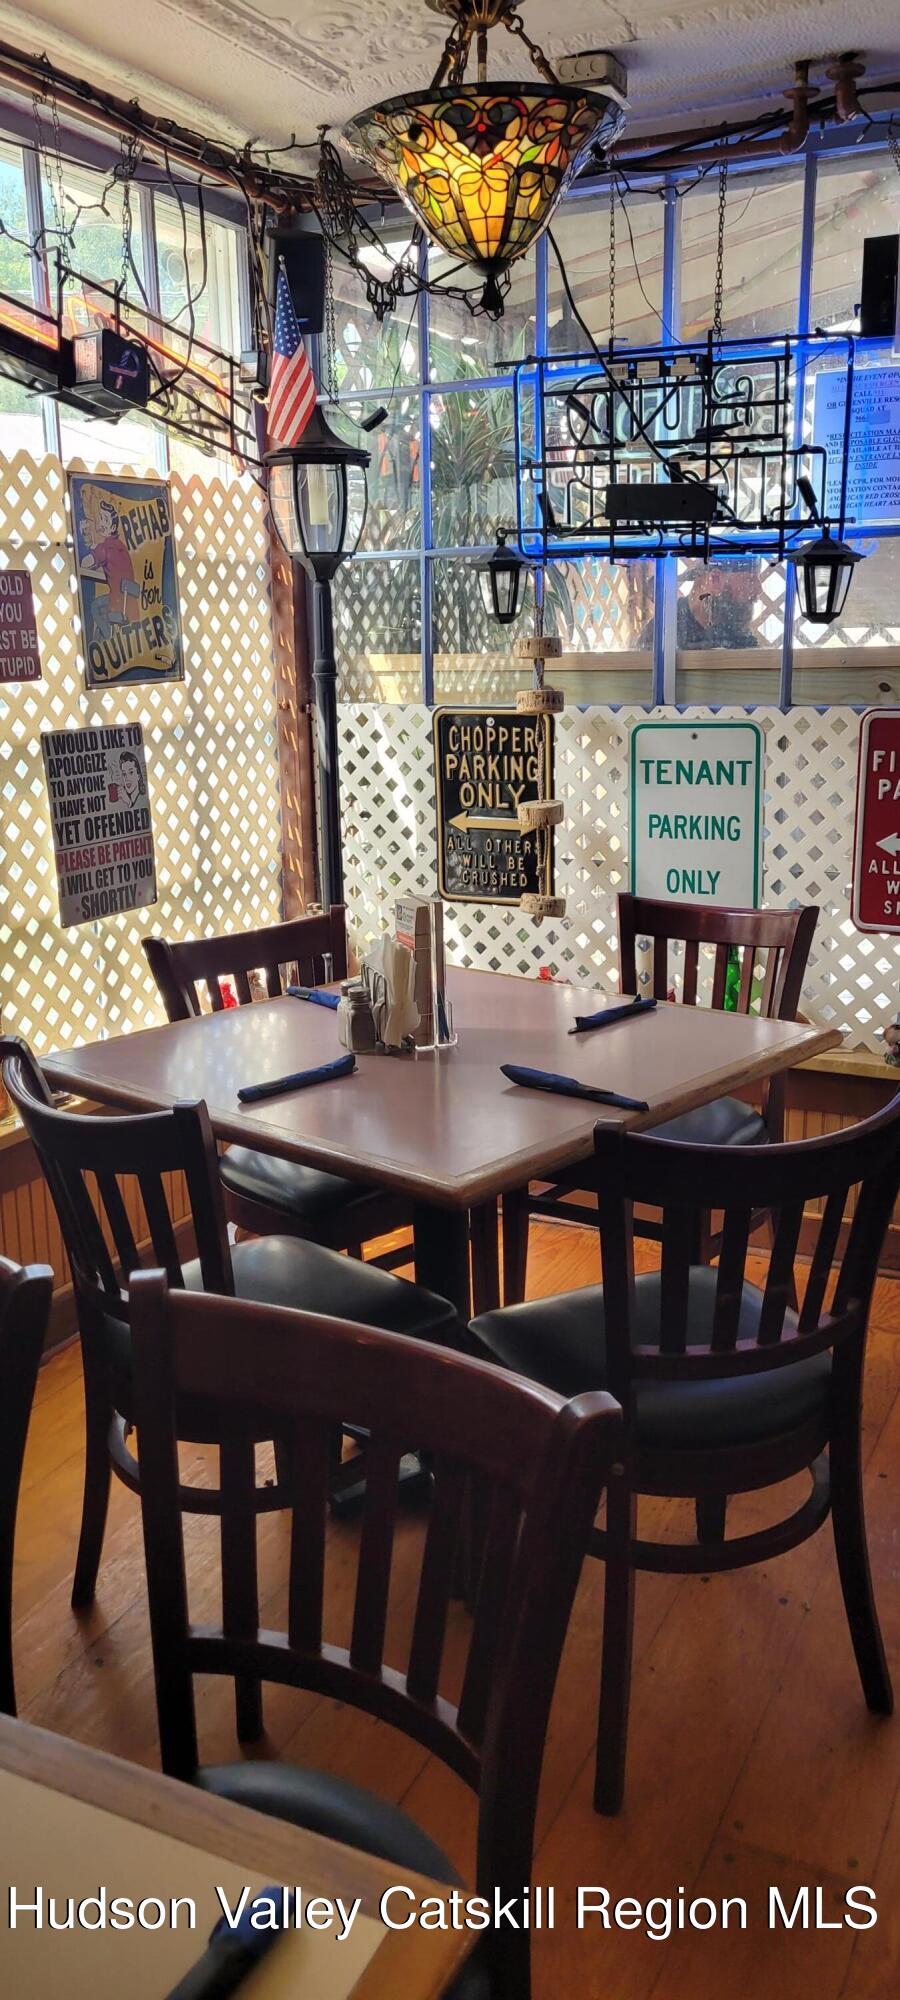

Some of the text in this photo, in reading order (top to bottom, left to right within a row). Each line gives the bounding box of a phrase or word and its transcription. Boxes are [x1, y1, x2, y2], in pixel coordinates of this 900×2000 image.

[120, 498, 169, 550] REHAB
[143, 560, 153, 580] is
[141, 582, 161, 611] for
[20, 629, 37, 649] BE
[88, 605, 178, 676] QUITTERS
[44, 727, 142, 756] I WOULD LIKE TO
[449, 725, 536, 753] CHOPPER
[48, 752, 107, 779] APOLOGIZE
[446, 753, 540, 782] PARKING
[640, 760, 752, 786] TENANT
[50, 774, 106, 798] TO ANYONE
[459, 782, 526, 809] ONLY
[53, 795, 106, 819] I HAVE NOT
[55, 807, 150, 846] YET OFFENDED
[648, 814, 741, 841] PARKING
[56, 835, 153, 873] PLEASE BE PATIENT
[447, 836, 472, 851] ALL
[462, 855, 525, 870] WILL BE
[868, 859, 900, 875] ALL
[61, 858, 153, 898] I WILL GET TO YOU
[462, 870, 528, 887] CRUSHED
[666, 868, 721, 895] ONLY
[81, 883, 137, 920] SHORTLY
